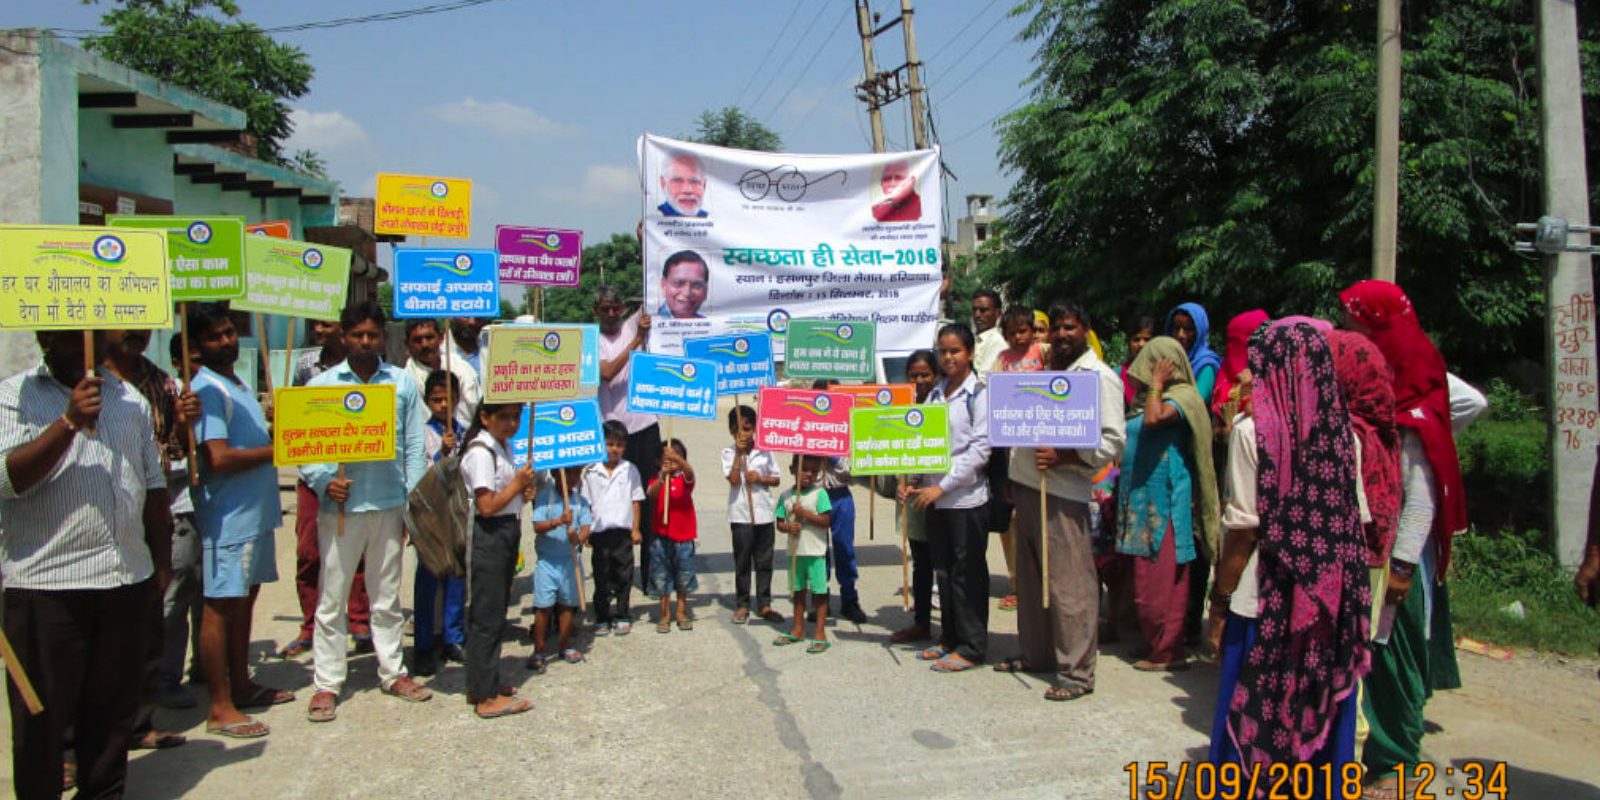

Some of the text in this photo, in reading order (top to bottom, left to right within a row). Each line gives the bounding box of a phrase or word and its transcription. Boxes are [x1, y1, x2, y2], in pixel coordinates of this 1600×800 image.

[720, 242, 939, 268] स्वच्छता ही सेवा-2018
[1, 268, 161, 294] हर घर शौचालय का अभियान
[400, 279, 442, 294] सफाई
[18, 298, 40, 323] देगा
[93, 297, 107, 320] को
[112, 303, 148, 322] सम्मान
[404, 296, 447, 310] बीमारी
[492, 360, 518, 380] प्रकृति
[520, 364, 532, 376] का
[762, 416, 802, 433] सफाई
[558, 430, 595, 444] भारत
[764, 431, 804, 447] बीमारी
